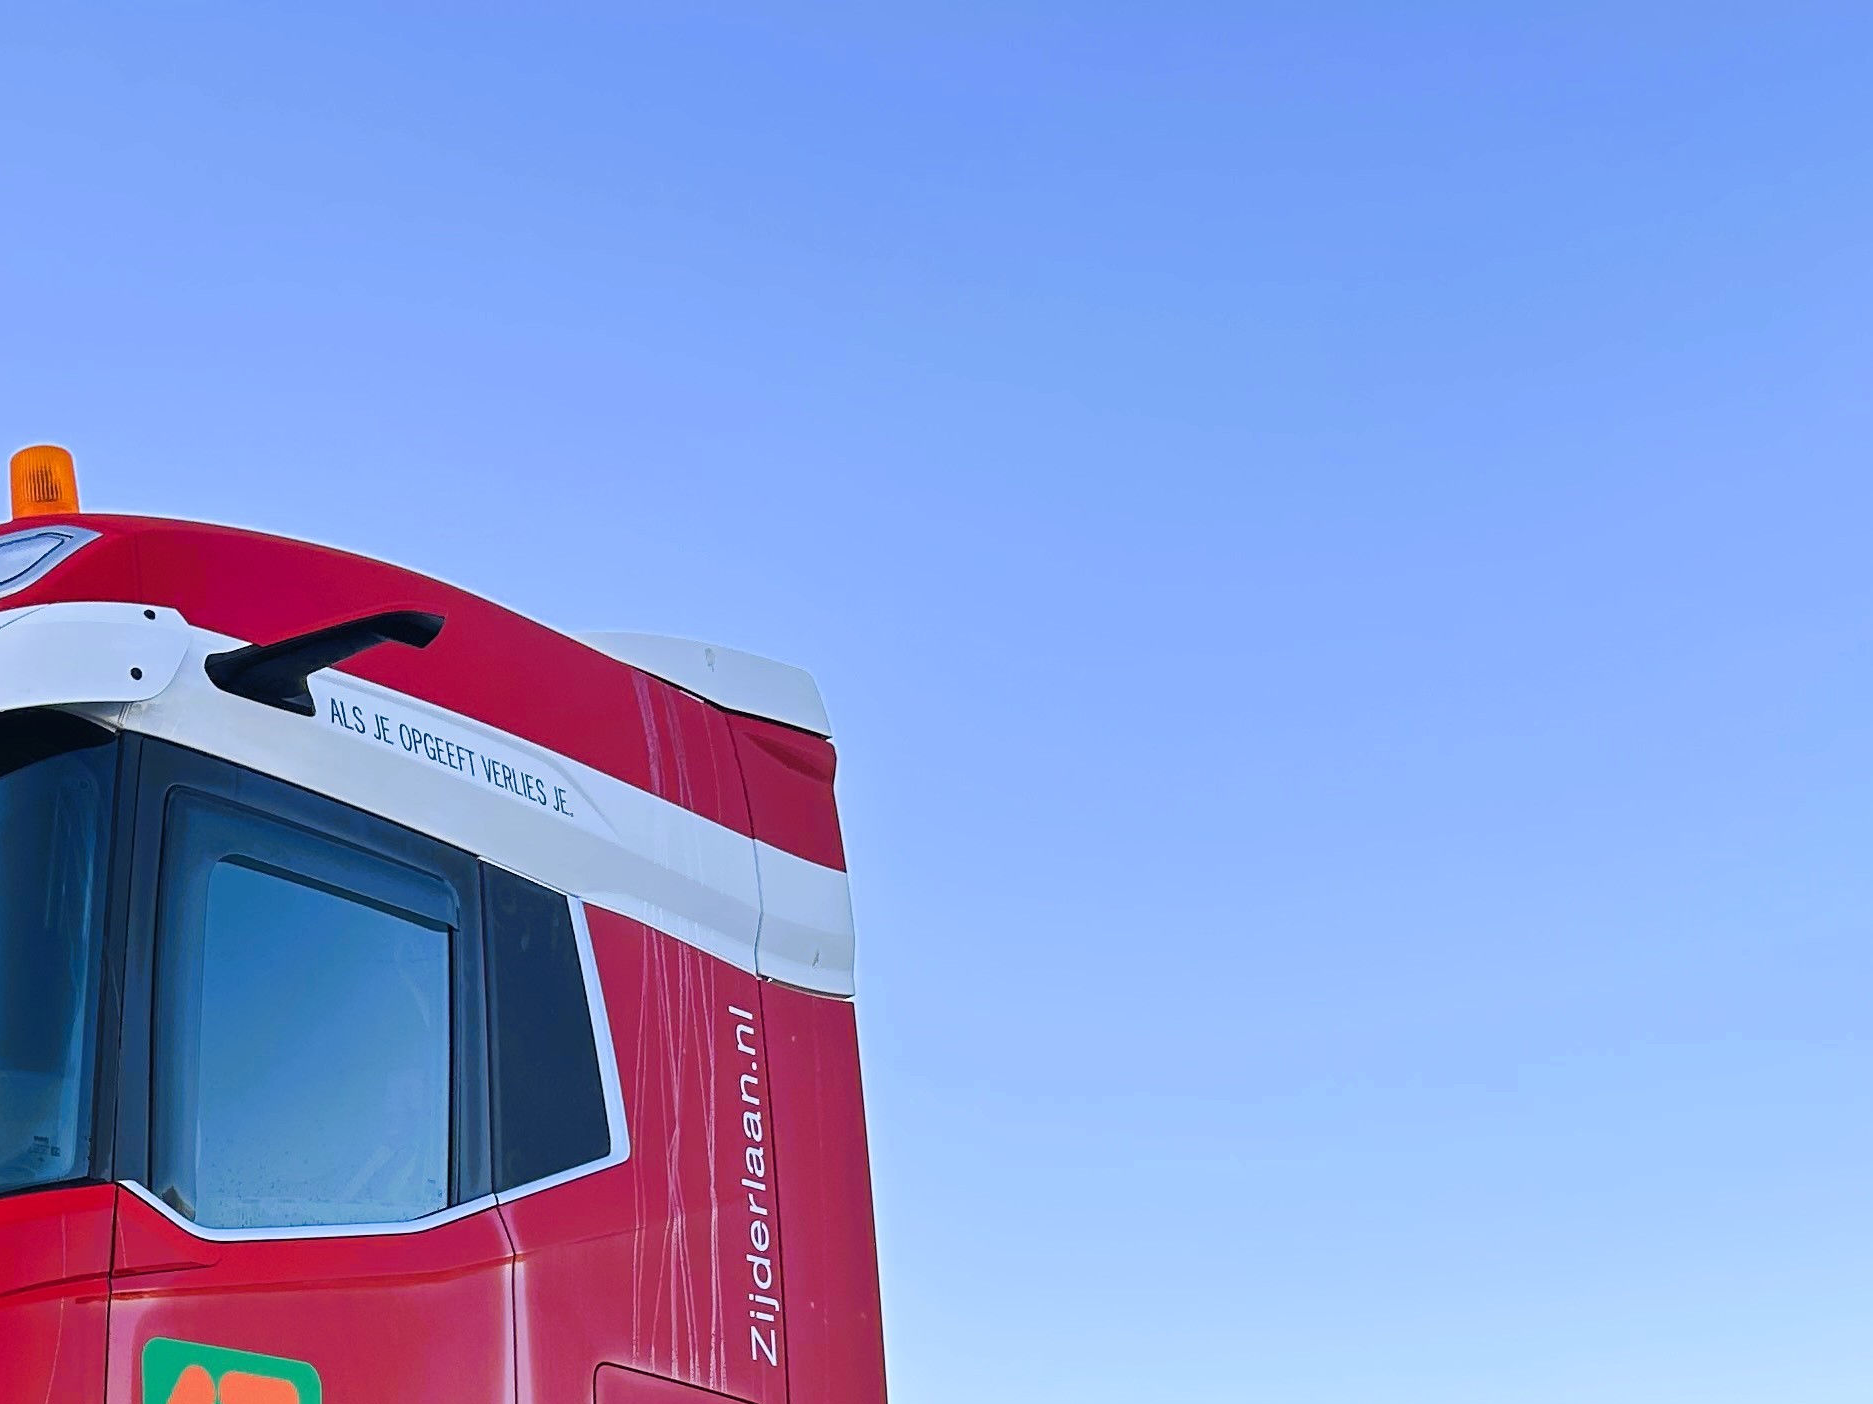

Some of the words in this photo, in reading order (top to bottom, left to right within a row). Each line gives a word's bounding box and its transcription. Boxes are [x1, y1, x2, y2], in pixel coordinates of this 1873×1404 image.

[330, 697, 366, 735] ALS
[373, 713, 394, 746] JE
[399, 722, 475, 777] OPGEEFT
[480, 754, 547, 806] VERLIES
[553, 785, 575, 818] JE.
[728, 1005, 780, 1367] Zijderlaan.nl
